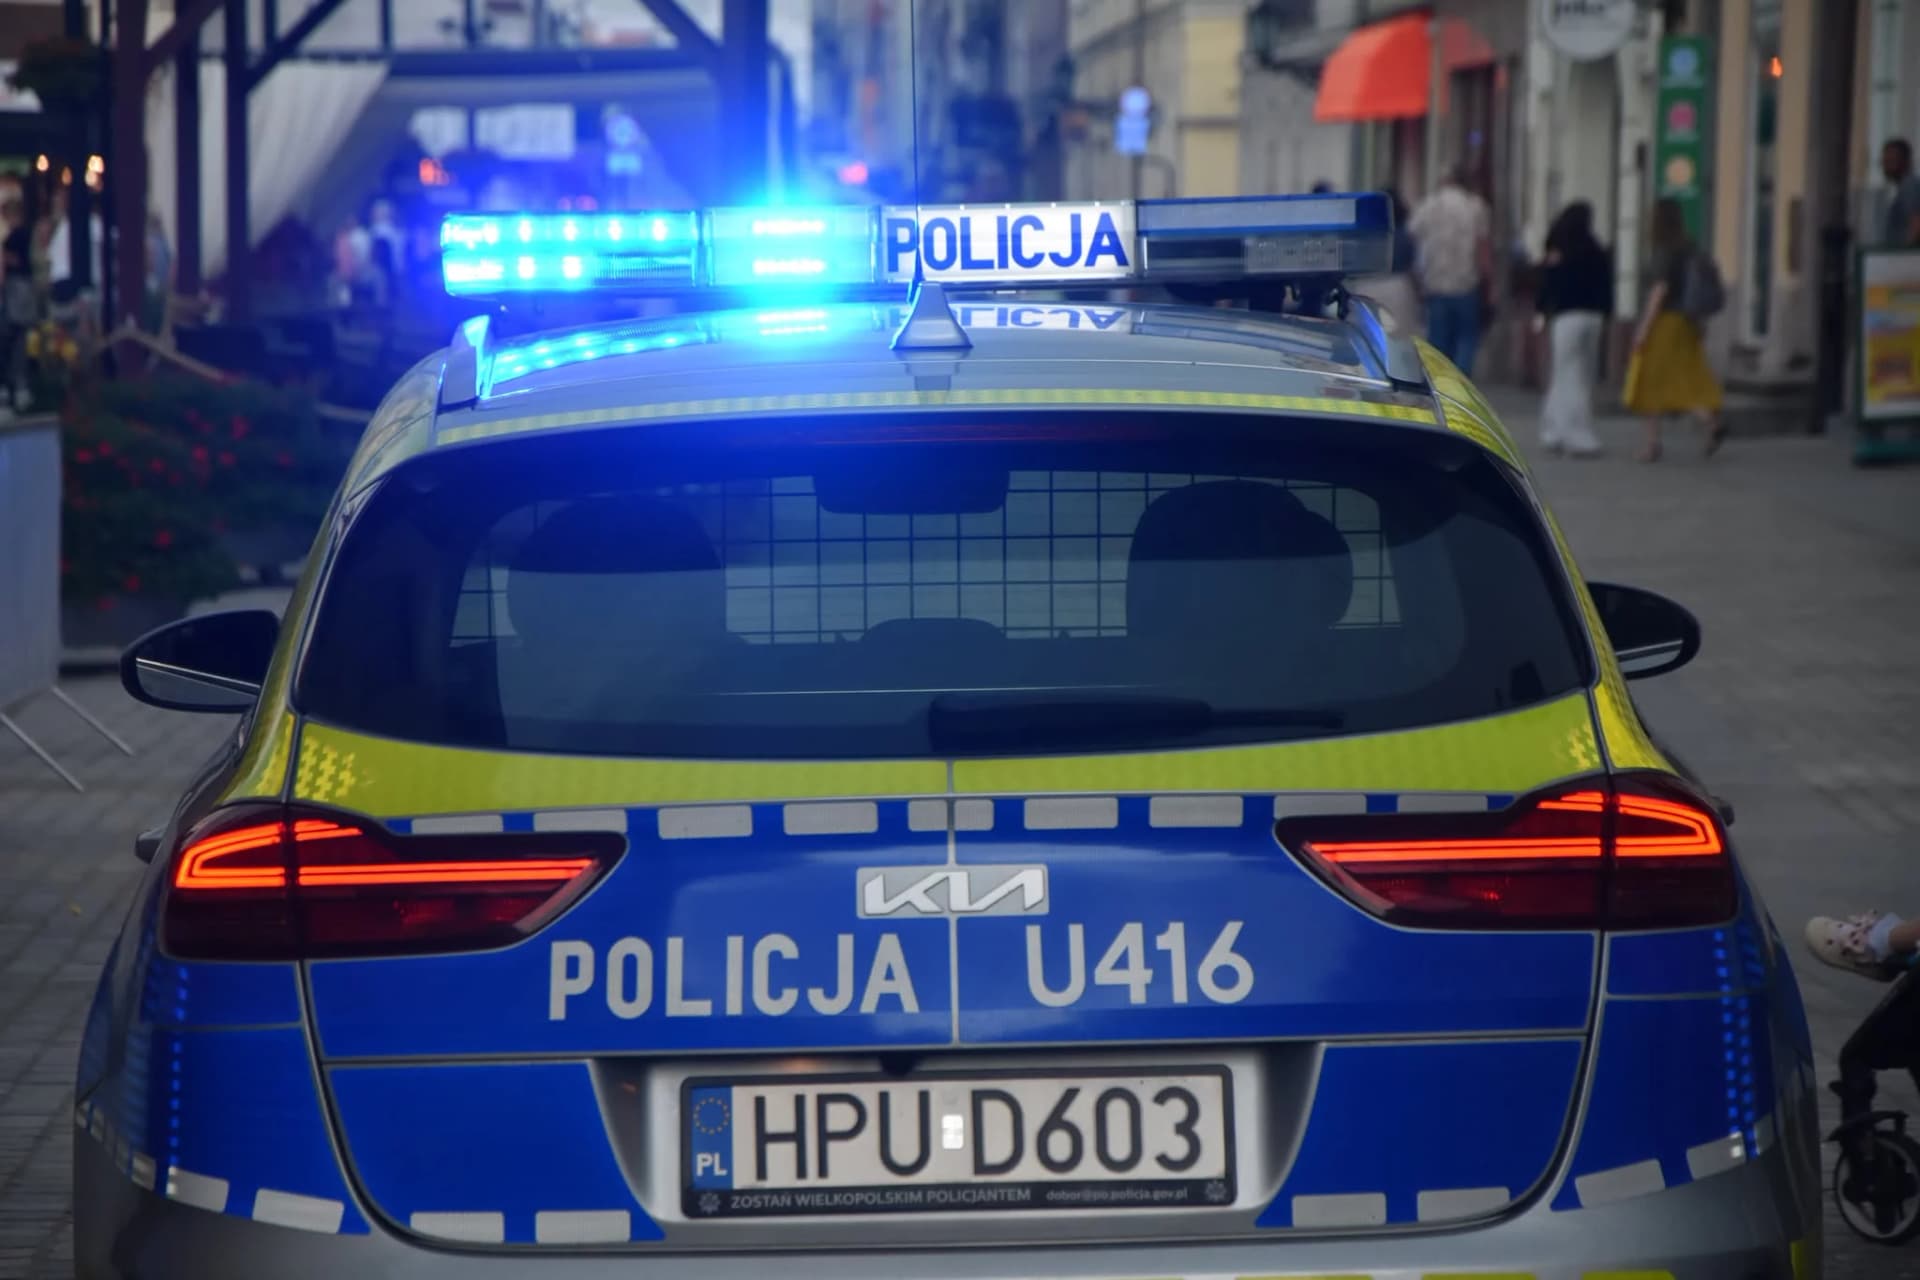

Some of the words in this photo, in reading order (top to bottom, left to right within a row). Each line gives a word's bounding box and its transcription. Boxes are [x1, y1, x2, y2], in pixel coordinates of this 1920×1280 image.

[886, 212, 1129, 273] POLICJA
[864, 868, 1046, 916] KIA
[549, 933, 919, 1020] POLICJA
[1025, 920, 1254, 1007] U416
[696, 1152, 728, 1176] PL
[754, 1089, 930, 1181] HPU
[971, 1086, 1201, 1176] D603
[730, 1192, 792, 1209] ZOSTAŃ
[796, 1189, 923, 1207] WIELKOPOLSKIM
[926, 1188, 1031, 1204] POLICJANTEM
